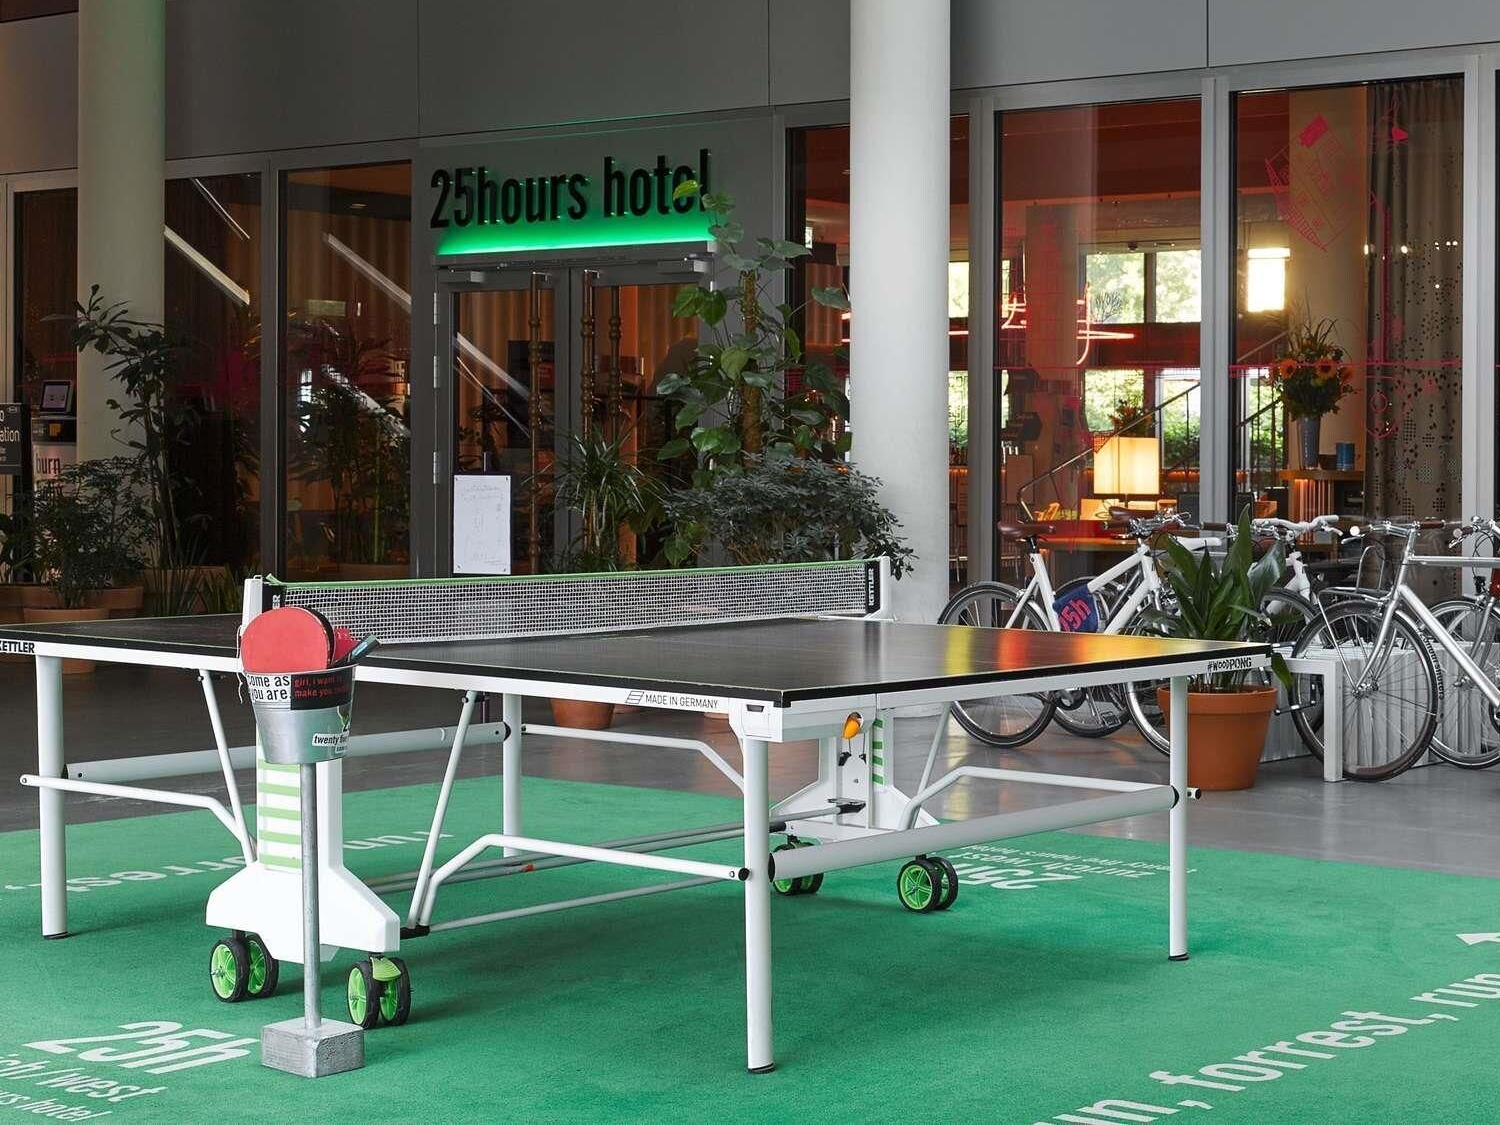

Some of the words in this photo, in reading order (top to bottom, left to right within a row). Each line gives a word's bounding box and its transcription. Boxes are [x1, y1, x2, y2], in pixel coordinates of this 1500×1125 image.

[430, 165, 591, 228] 25hours
[604, 148, 711, 219] hotel
[0, 640, 35, 654] ETTLER
[274, 675, 290, 687] as
[645, 694, 668, 706] MADE
[669, 696, 678, 706] IN
[679, 697, 719, 709] GERMANY
[314, 735, 340, 746] twenty
[22, 1021, 263, 1074] 25h
[1149, 1009, 1460, 1092] forrest,
